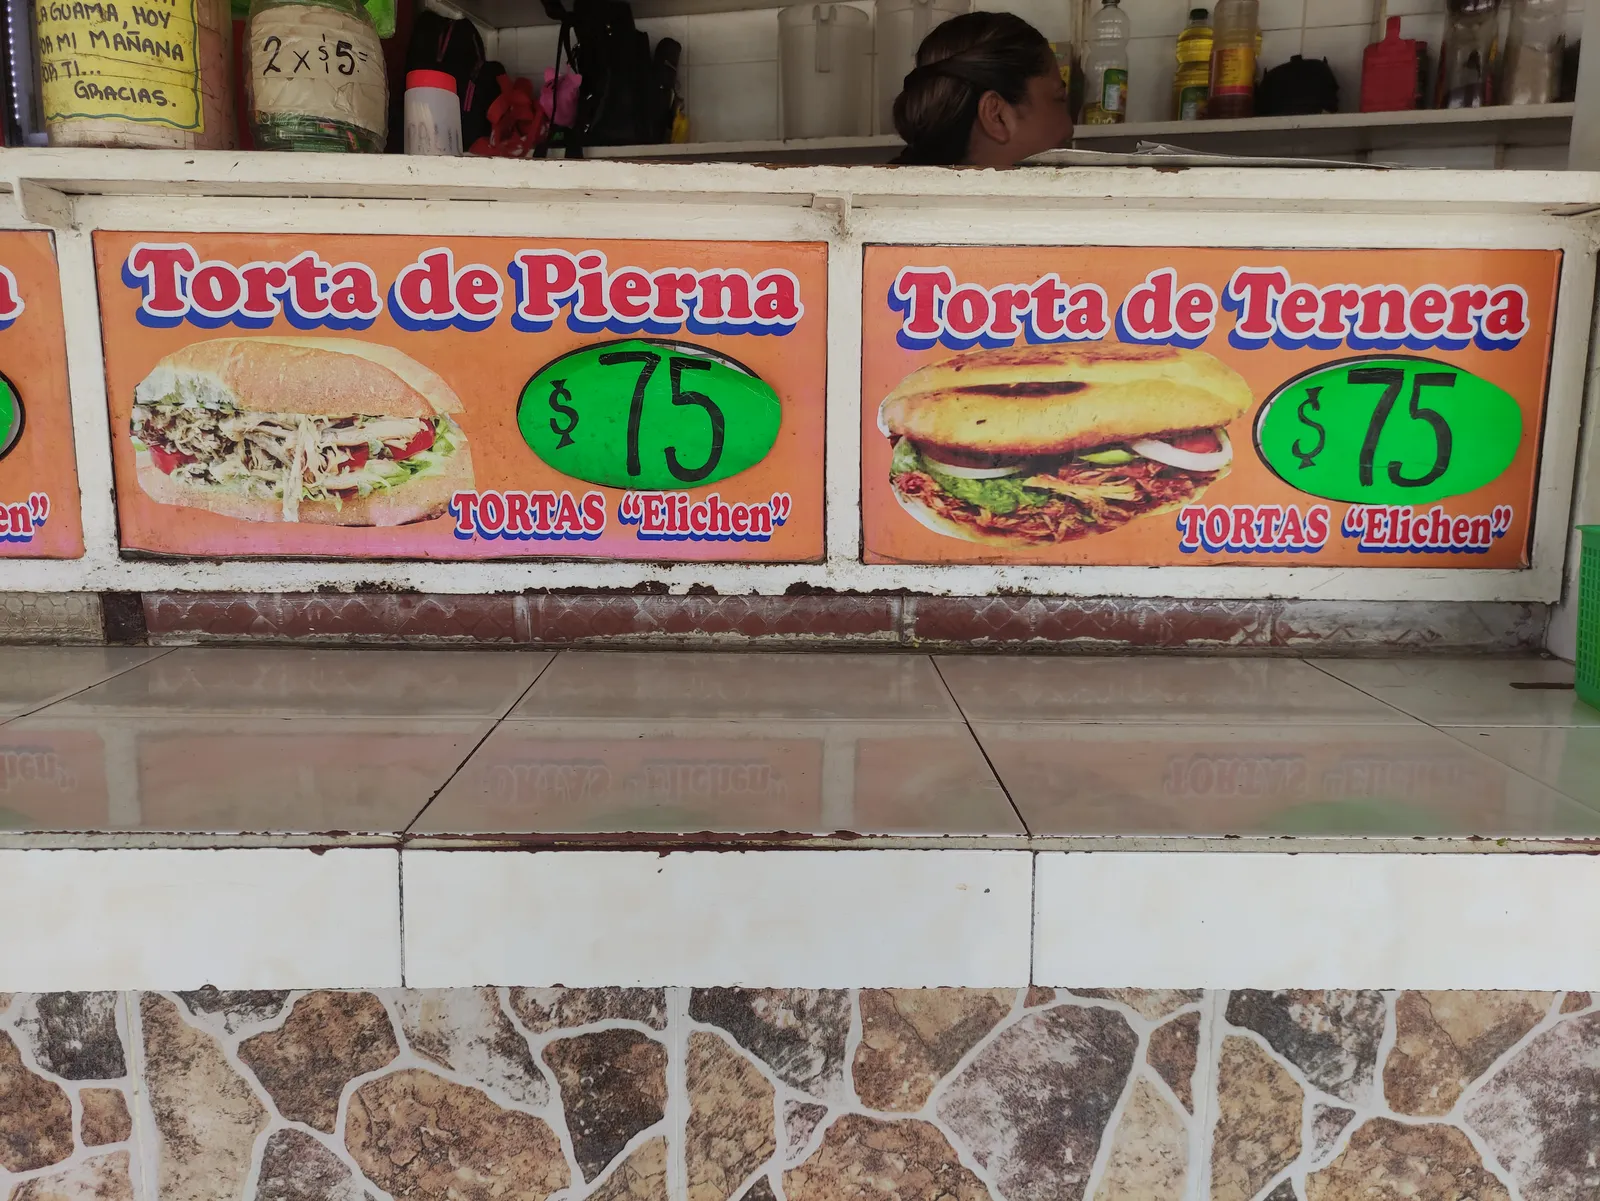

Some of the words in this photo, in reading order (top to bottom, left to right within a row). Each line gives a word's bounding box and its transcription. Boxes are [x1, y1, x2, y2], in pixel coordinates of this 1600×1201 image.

[38, 2, 127, 29] AGUAMA,
[132, 5, 171, 29] HOY
[56, 32, 77, 52] MI
[89, 30, 184, 62] MAÑANA
[262, 35, 282, 76] 2
[61, 60, 101, 79] TI...
[74, 80, 177, 107] GRACIAS.
[126, 242, 383, 322] Torta
[395, 247, 503, 324] de
[514, 249, 804, 325] Pierna
[894, 266, 1110, 341] Torta
[1123, 267, 1218, 341] de
[1229, 266, 1530, 341] Ternera
[598, 351, 726, 483] 75
[1346, 367, 1457, 488] 75
[450, 489, 606, 536] TORTAS
[620, 491, 791, 537] “Elichen”
[1178, 504, 1330, 549] TORTAS
[1343, 505, 1513, 549] “Elichen”
